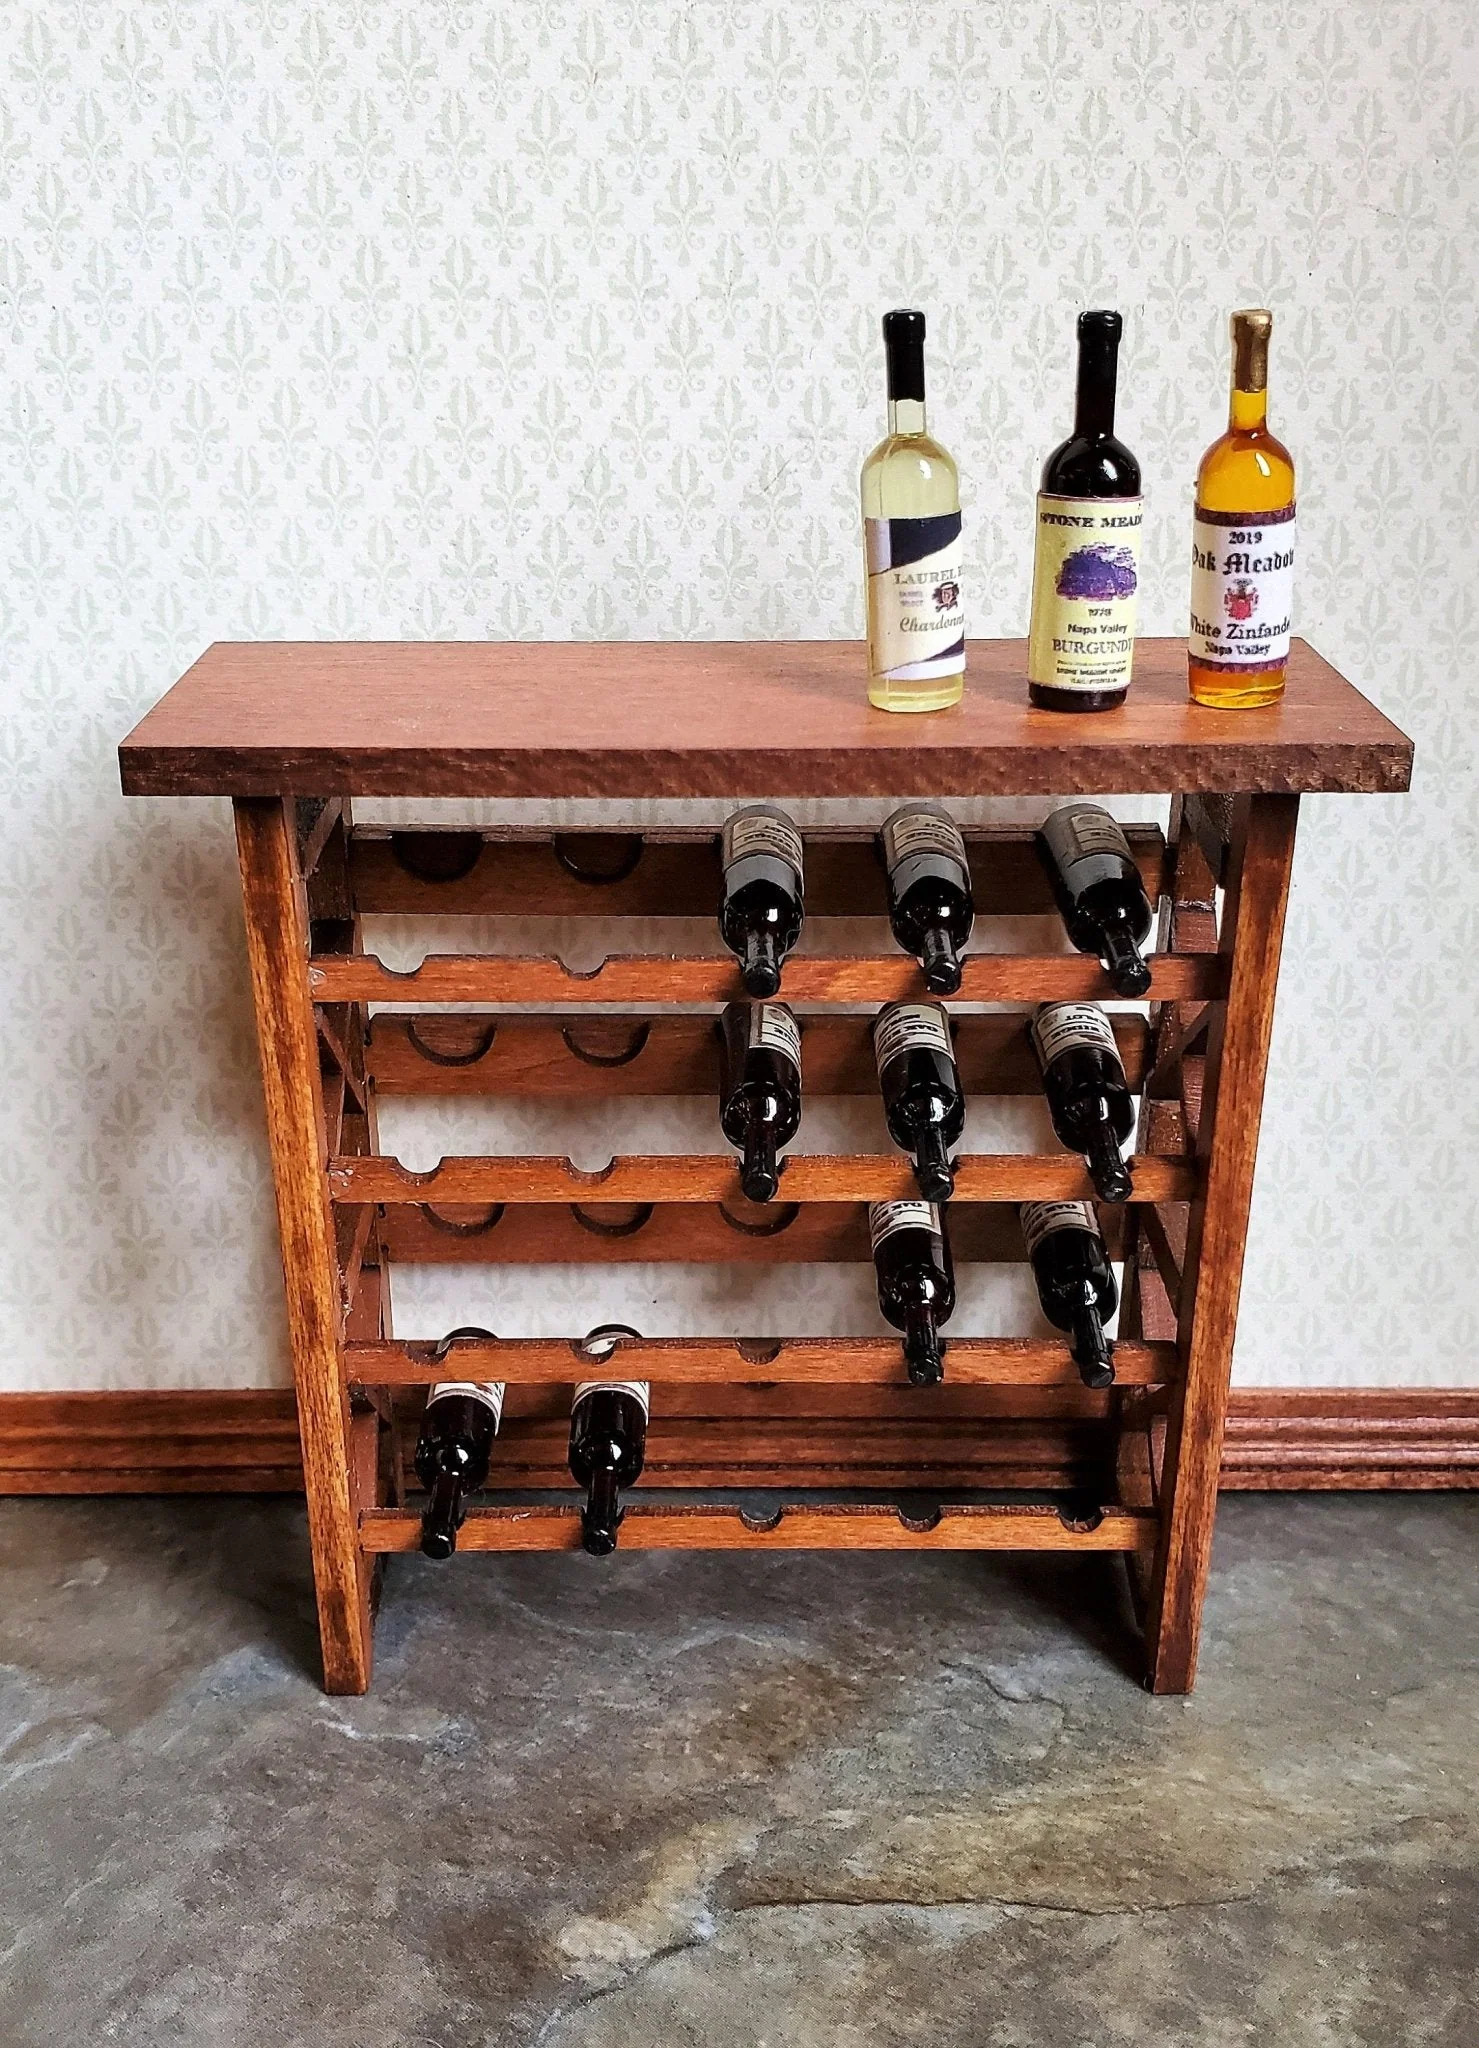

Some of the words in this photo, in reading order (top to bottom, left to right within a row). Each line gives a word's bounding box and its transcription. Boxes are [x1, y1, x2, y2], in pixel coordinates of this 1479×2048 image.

[1228, 531, 1262, 544] 2019
[1067, 624, 1097, 635] Napa
[1100, 624, 1127, 634] Valley
[1205, 641, 1232, 656] Napa
[1236, 644, 1270, 656] Valley
